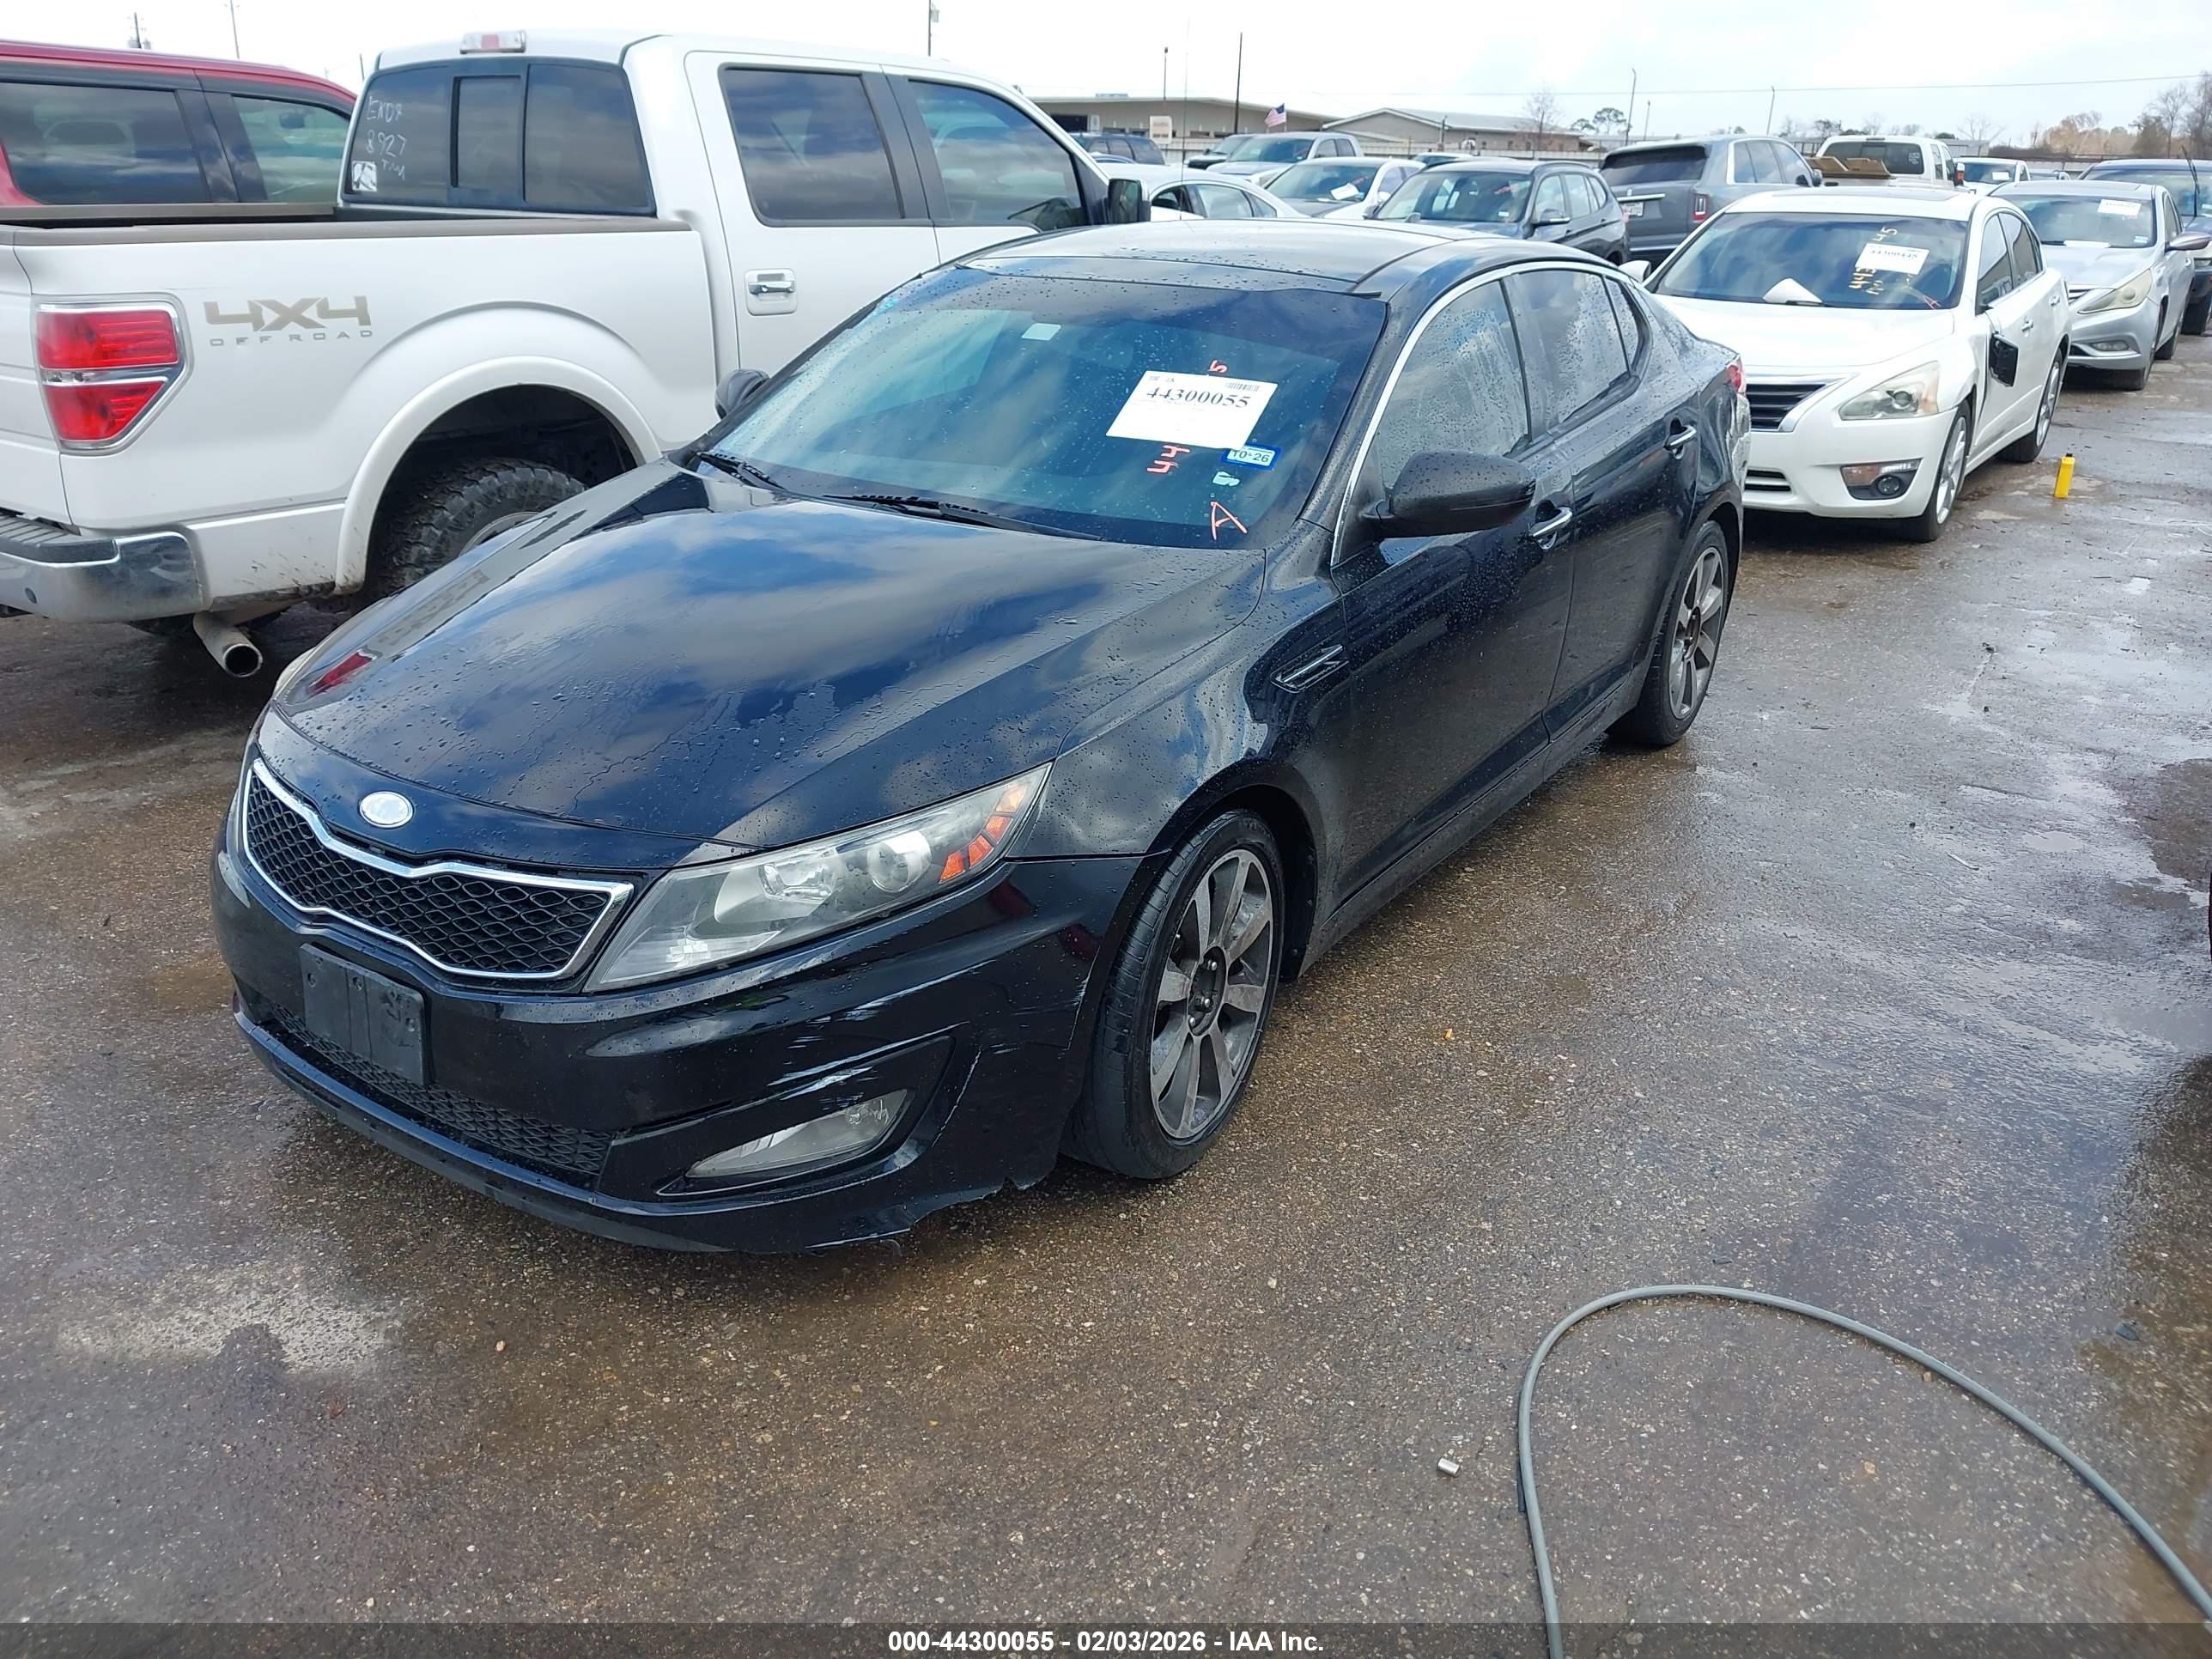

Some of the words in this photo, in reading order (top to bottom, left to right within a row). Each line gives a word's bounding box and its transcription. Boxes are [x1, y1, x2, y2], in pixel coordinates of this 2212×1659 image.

[204, 295, 371, 332] 4X4
[210, 336, 272, 347] OFF
[289, 331, 373, 342] ROAD
[1146, 386, 1252, 409] 44300055
[1210, 501, 1248, 541] A
